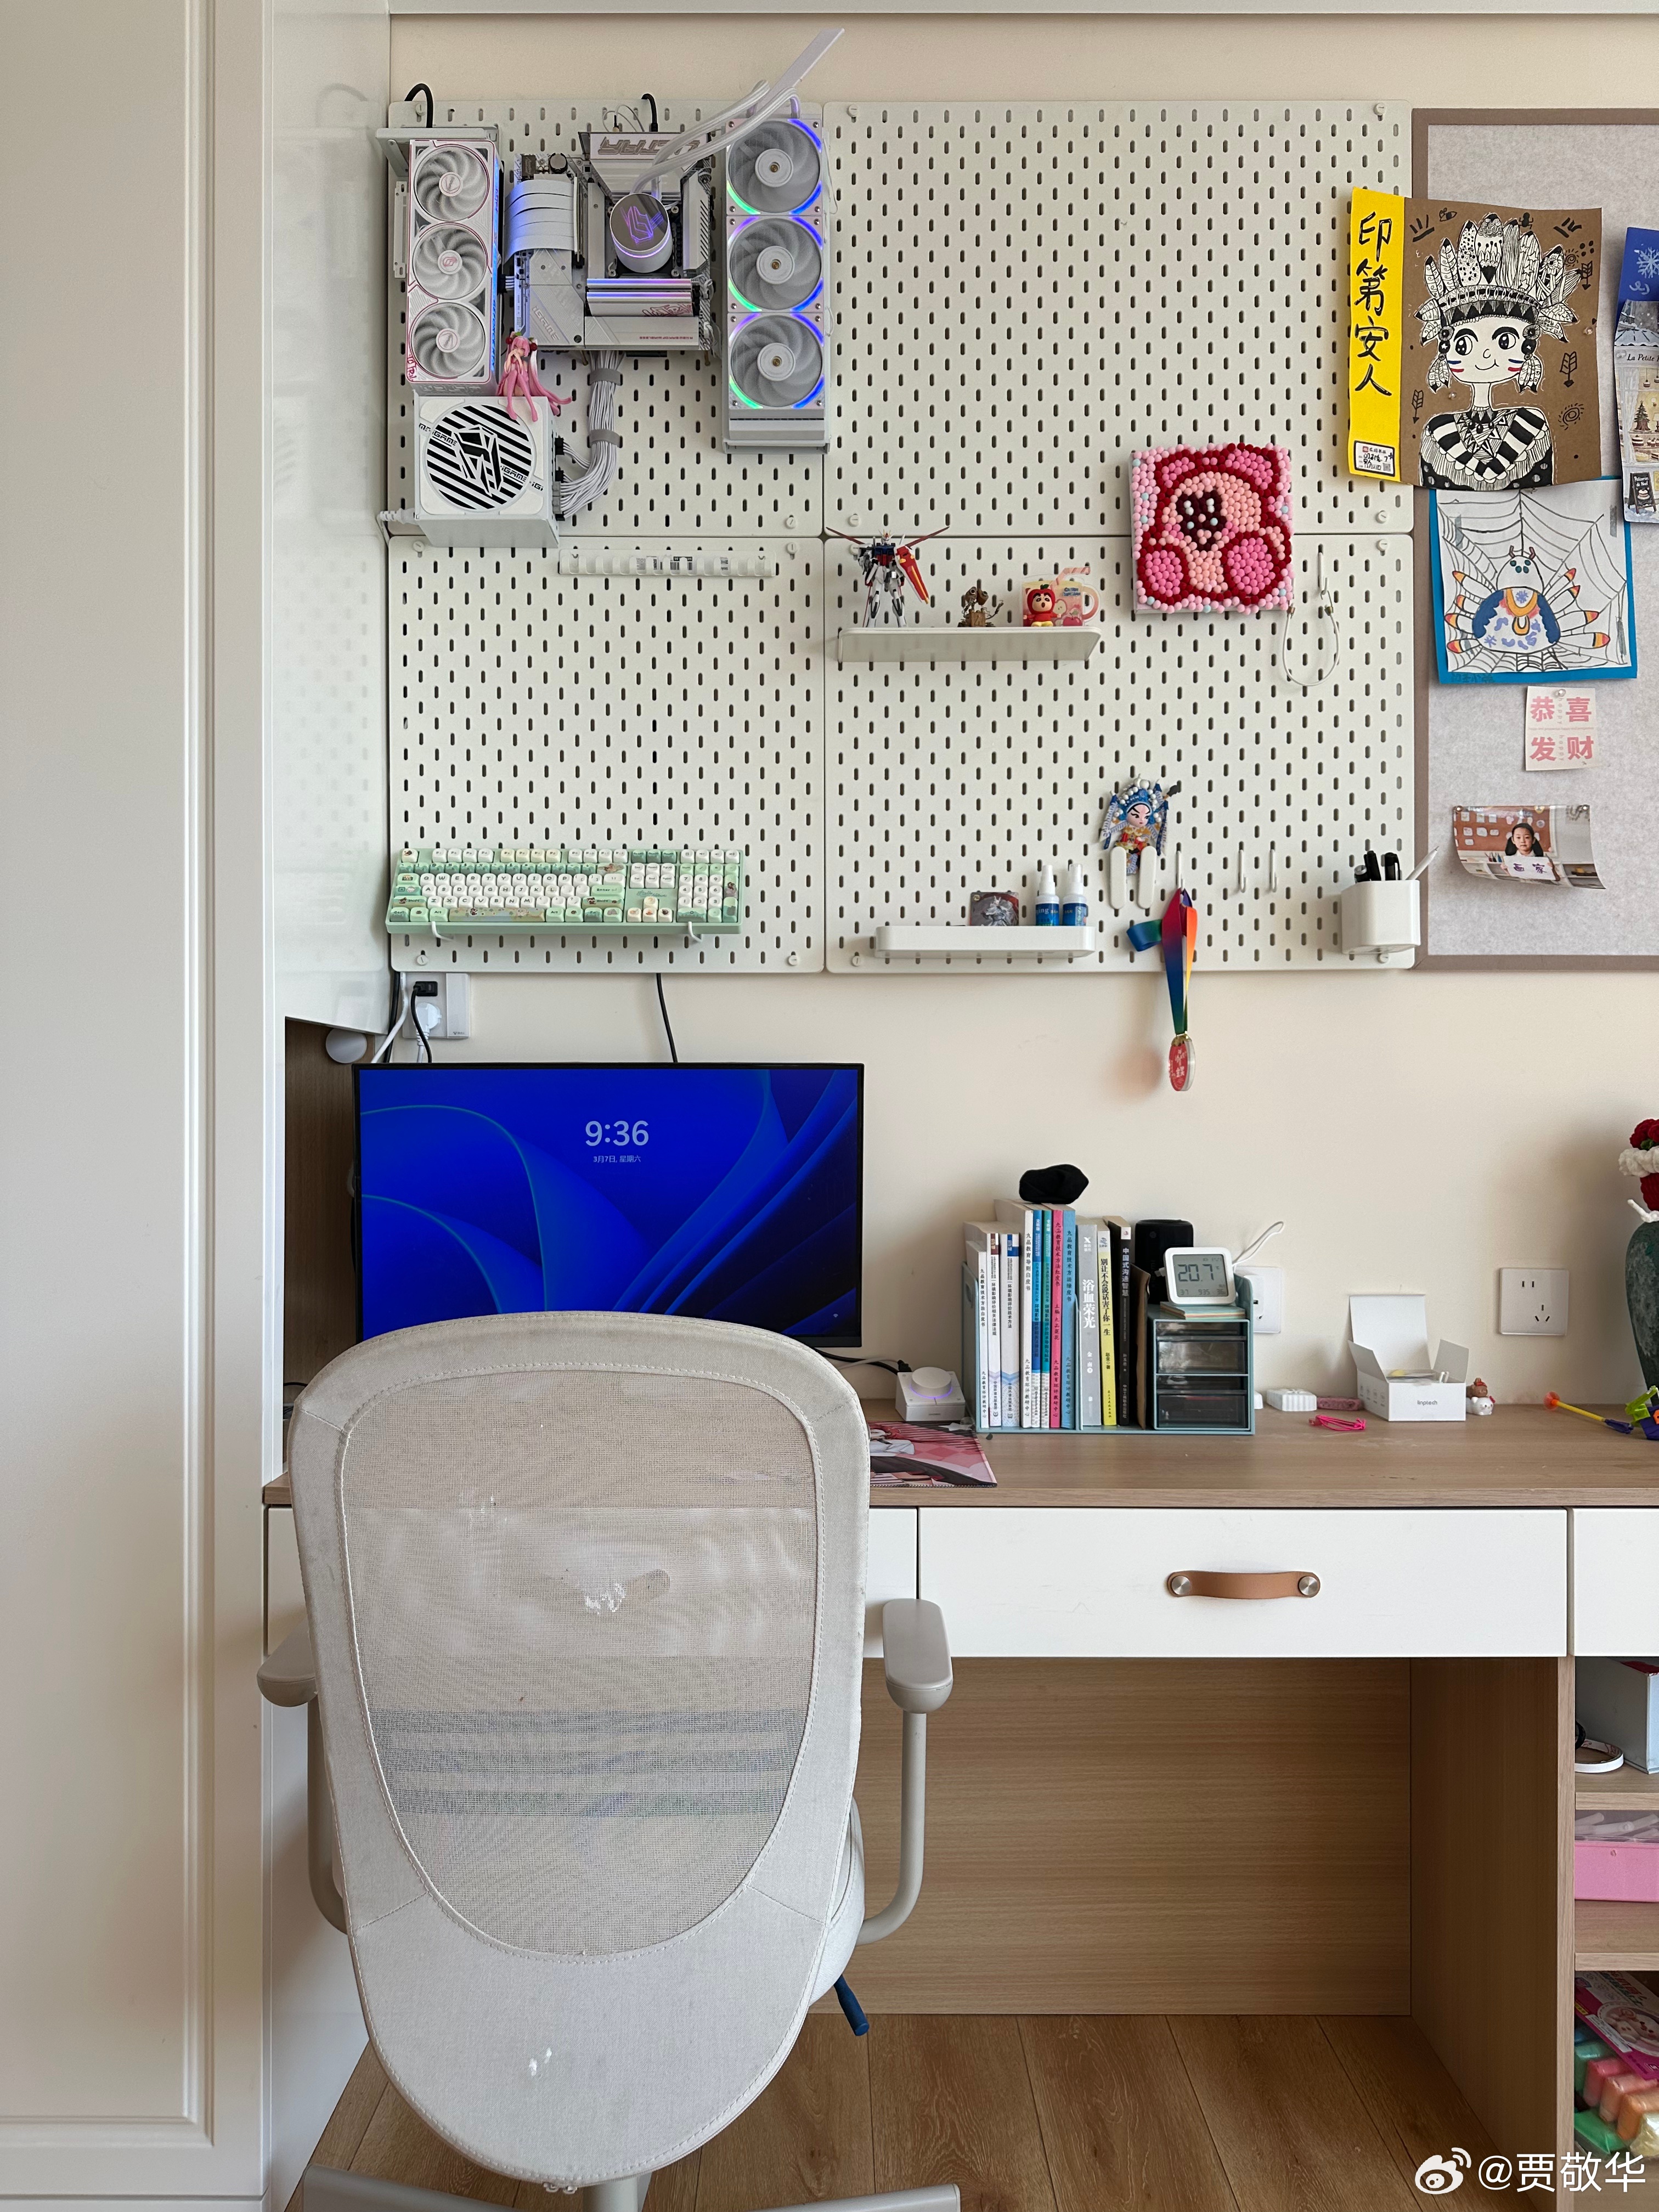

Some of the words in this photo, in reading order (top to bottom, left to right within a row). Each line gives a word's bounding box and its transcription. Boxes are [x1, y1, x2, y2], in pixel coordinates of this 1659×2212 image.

[1354, 211, 1392, 396] 印第安人
[1638, 353, 1655, 362] Petite
[1530, 696, 1592, 722] 恭喜
[1530, 736, 1594, 761] 发财
[585, 1120, 648, 1146] 9:36
[1122, 1248, 1130, 1296] 中国式沟通智慧
[1177, 1264, 1214, 1282] 20.7
[1082, 1279, 1096, 1328] 浴血荣光
[1101, 1259, 1111, 1336] 别让不会说话害了你一生
